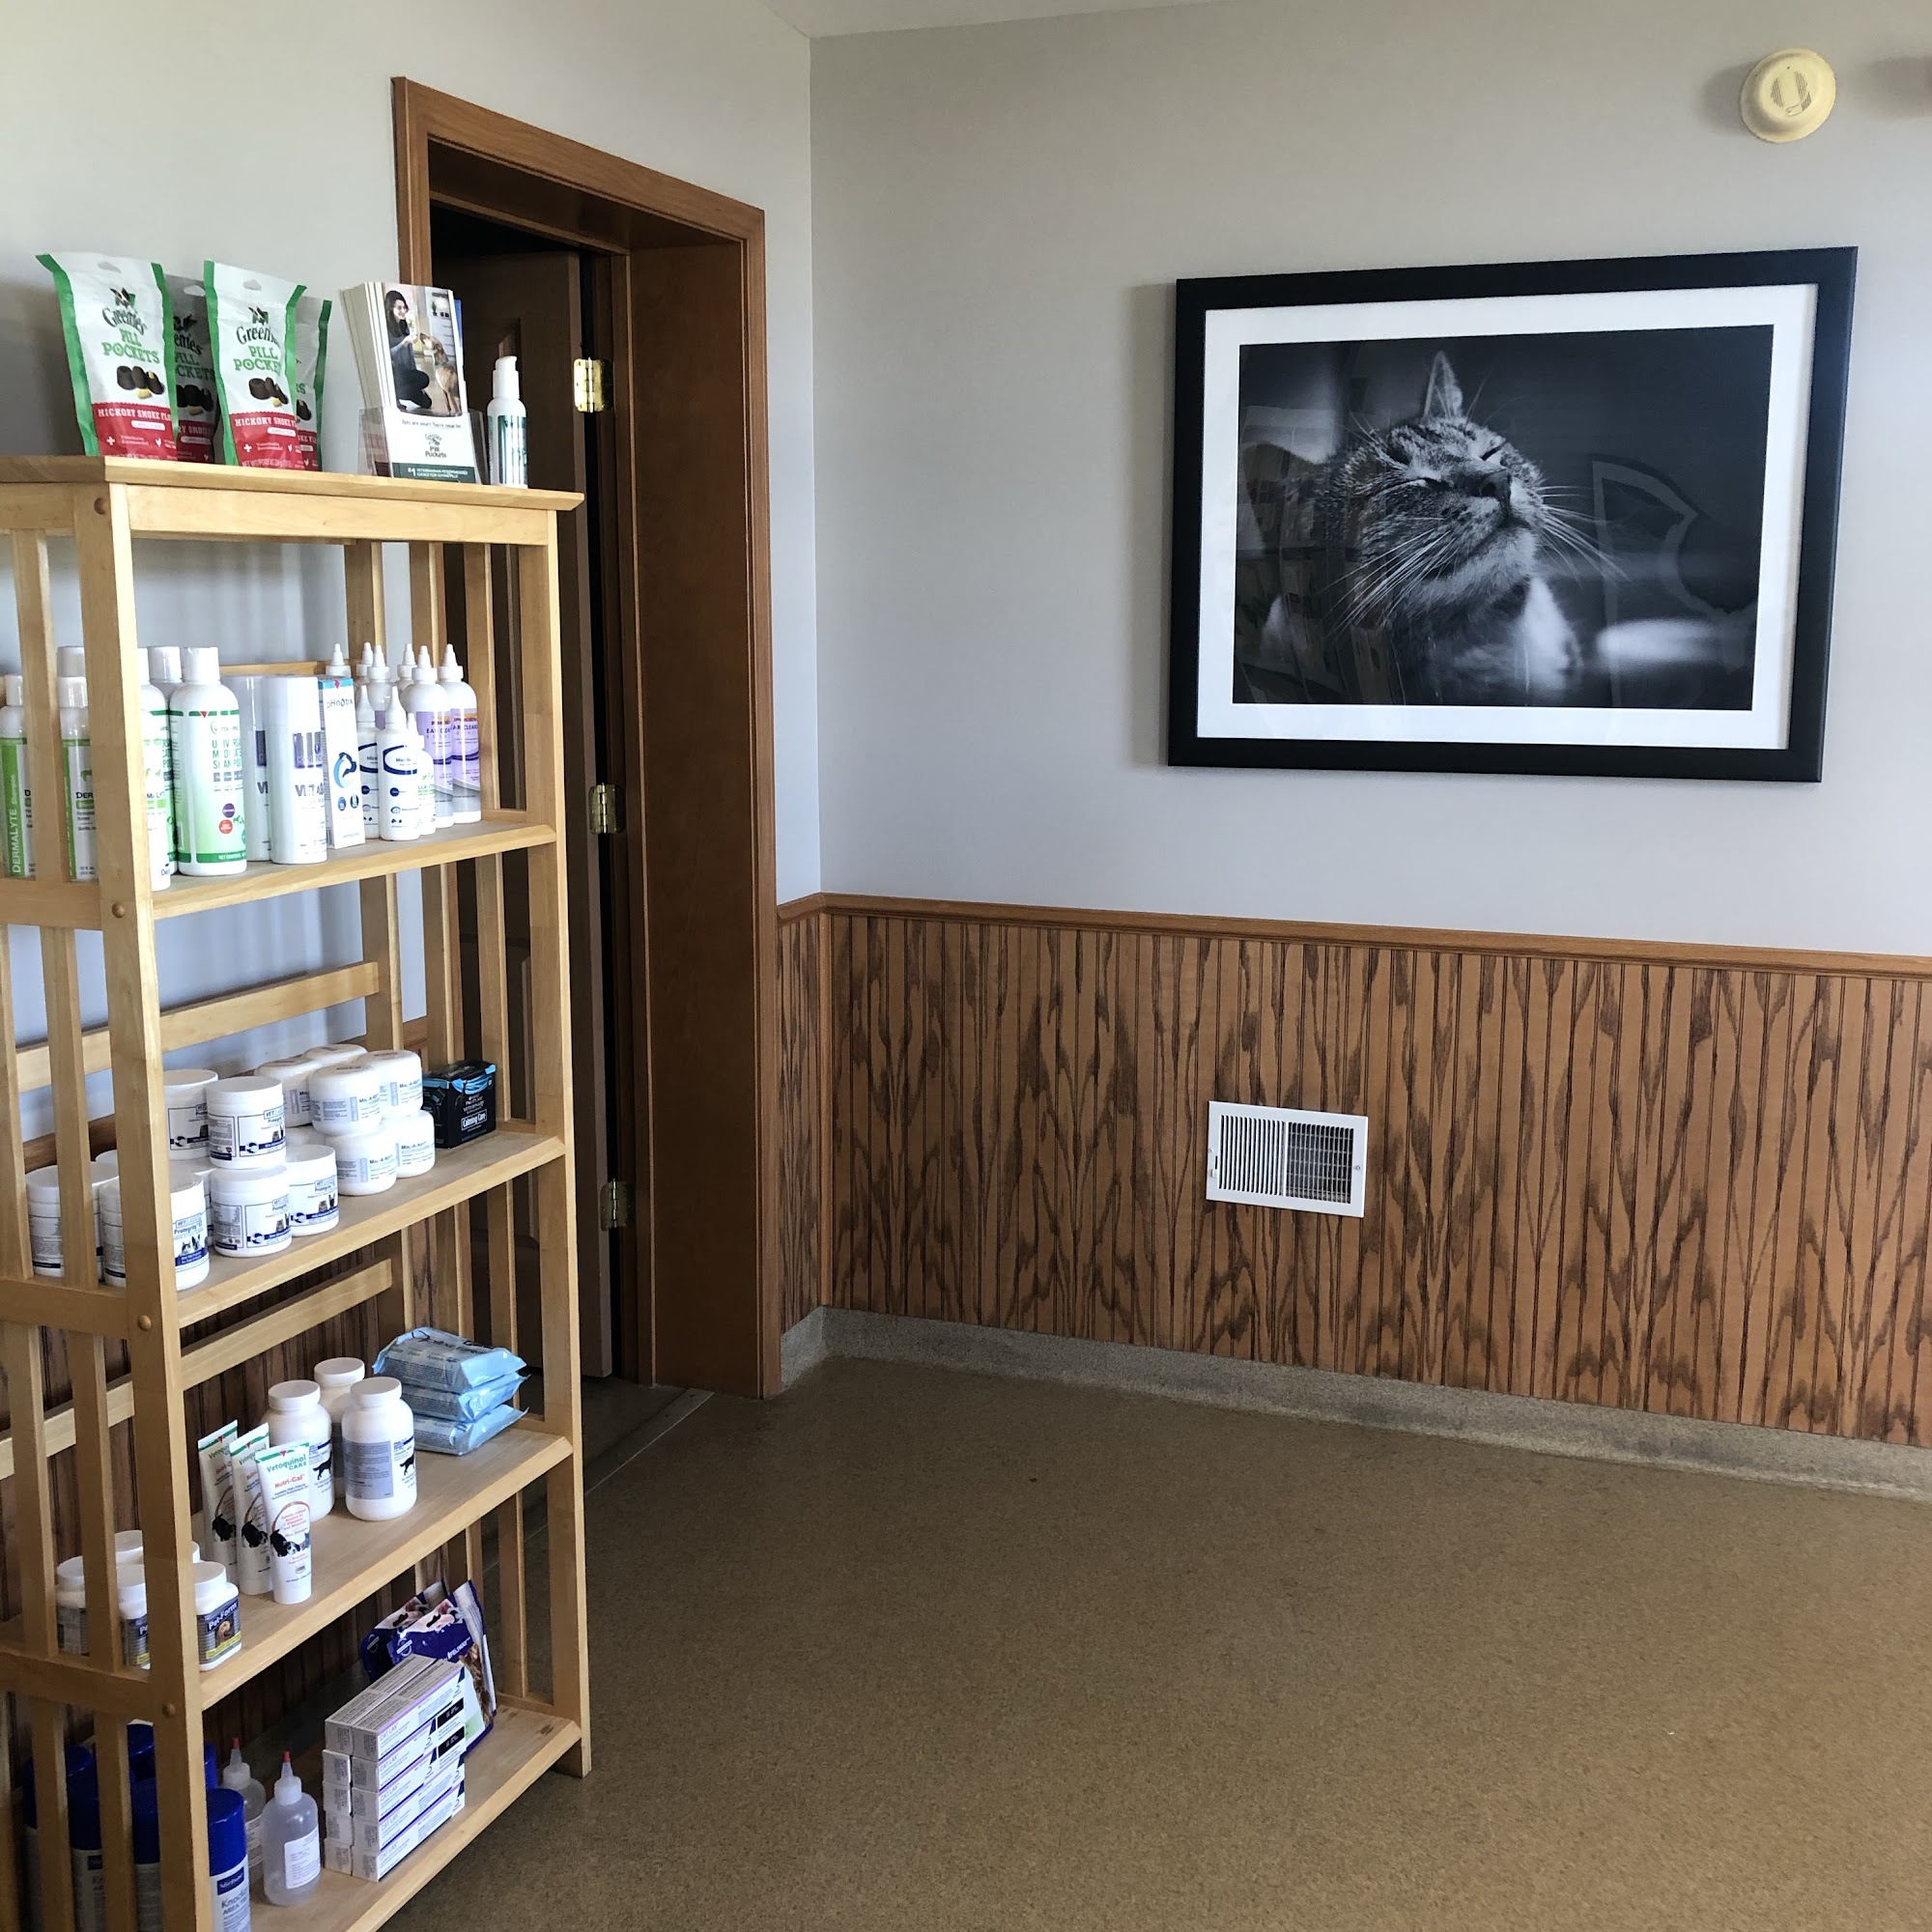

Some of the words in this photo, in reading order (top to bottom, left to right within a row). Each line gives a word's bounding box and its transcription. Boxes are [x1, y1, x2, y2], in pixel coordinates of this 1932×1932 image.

[101, 306, 148, 336] Greenies
[119, 328, 143, 347] PILL
[100, 341, 160, 364] POCKETS
[247, 345, 279, 360] PILL
[176, 364, 215, 383] CKETS
[98, 408, 136, 418] HICKORY
[136, 409, 160, 420] SMOKE
[235, 416, 272, 427] HICKORY
[273, 416, 292, 427] SMOKE
[9, 808, 21, 873] DERMALYTE
[463, 1116, 477, 1128] Calming
[477, 1113, 486, 1122] Care
[174, 1224, 197, 1236] Protegrity
[267, 1454, 307, 1473] Vetoquinol
[289, 1462, 307, 1470] CARE
[208, 1601, 238, 1631] Pet-Form
[221, 1887, 248, 1909] Knoc
